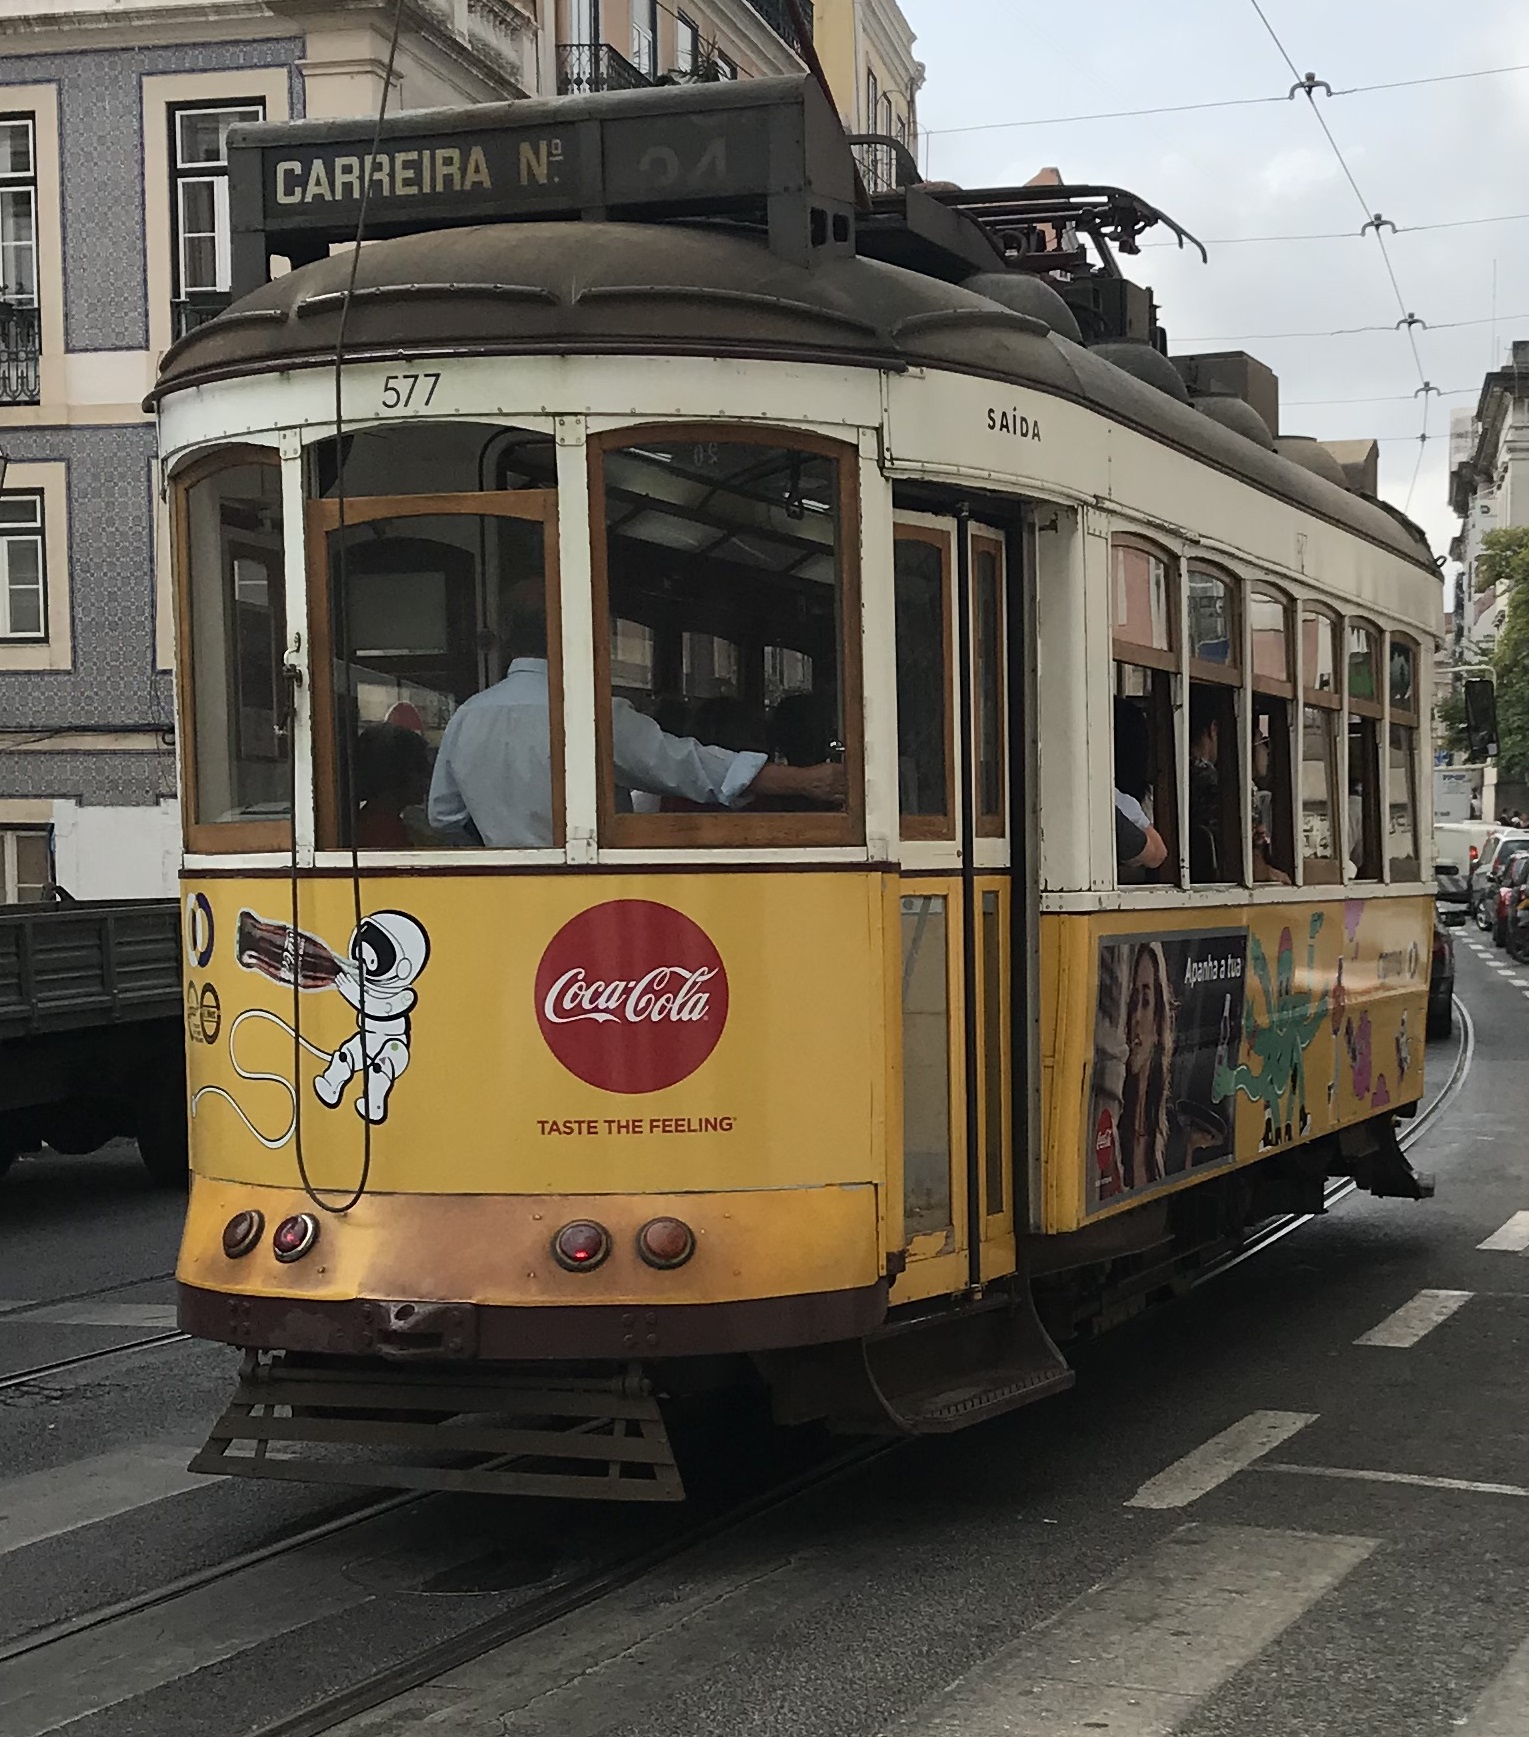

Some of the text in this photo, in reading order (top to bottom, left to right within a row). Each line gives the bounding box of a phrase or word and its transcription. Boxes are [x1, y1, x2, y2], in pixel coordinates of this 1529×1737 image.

[276, 145, 492, 205] CARREIRA
[382, 372, 442, 409] 577
[987, 405, 1042, 442] SAÍDA
[1184, 954, 1218, 988] Apanha
[544, 966, 719, 1024] Coca-Cola
[537, 1116, 734, 1136] TASTE THE FEELING
